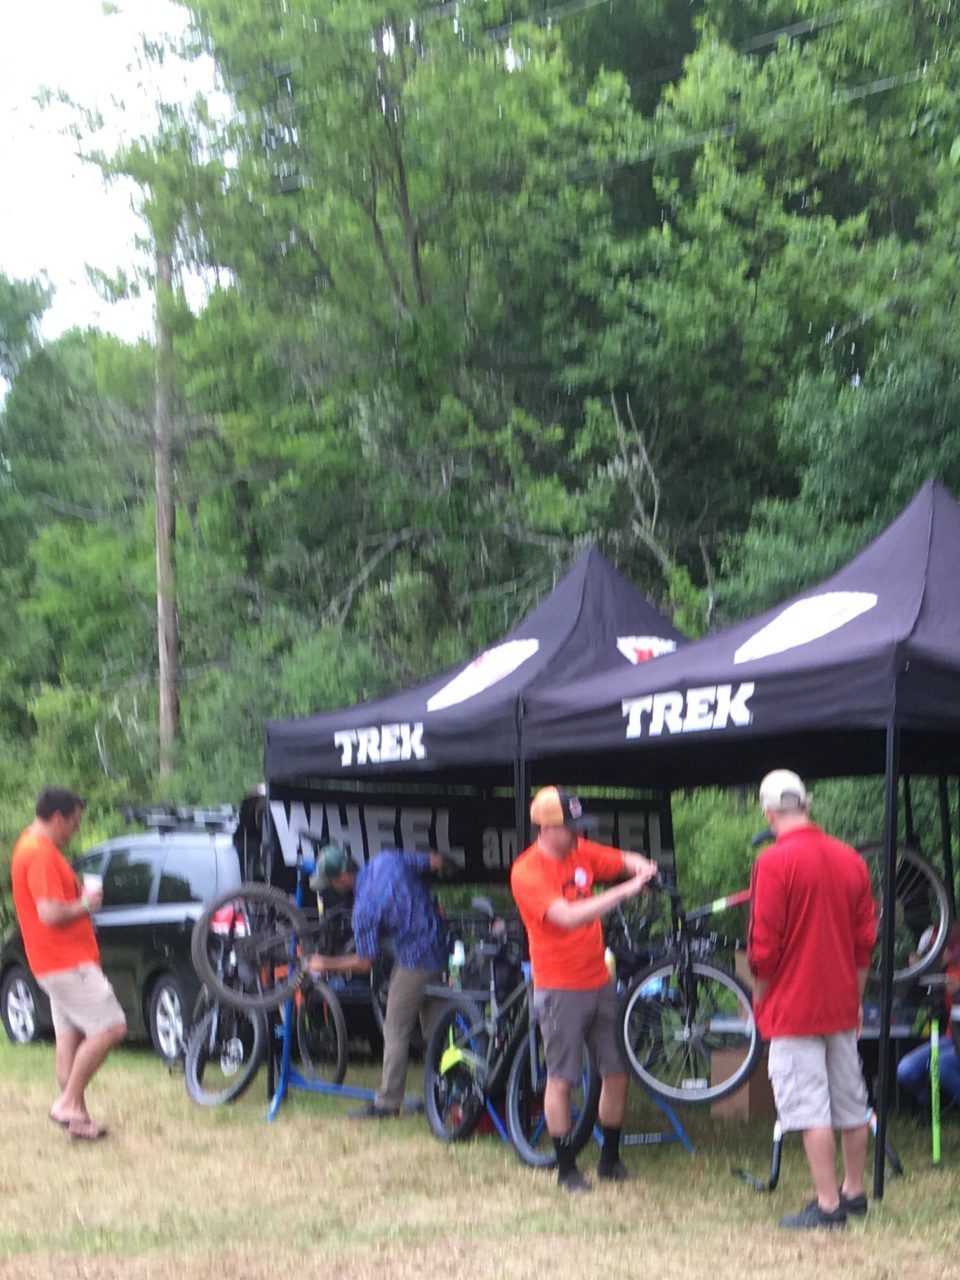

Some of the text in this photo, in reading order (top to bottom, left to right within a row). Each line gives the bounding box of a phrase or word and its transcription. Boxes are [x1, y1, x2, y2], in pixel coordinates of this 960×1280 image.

[622, 677, 755, 740] TREK
[334, 722, 427, 767] TREK
[269, 799, 466, 870] WHEEL
